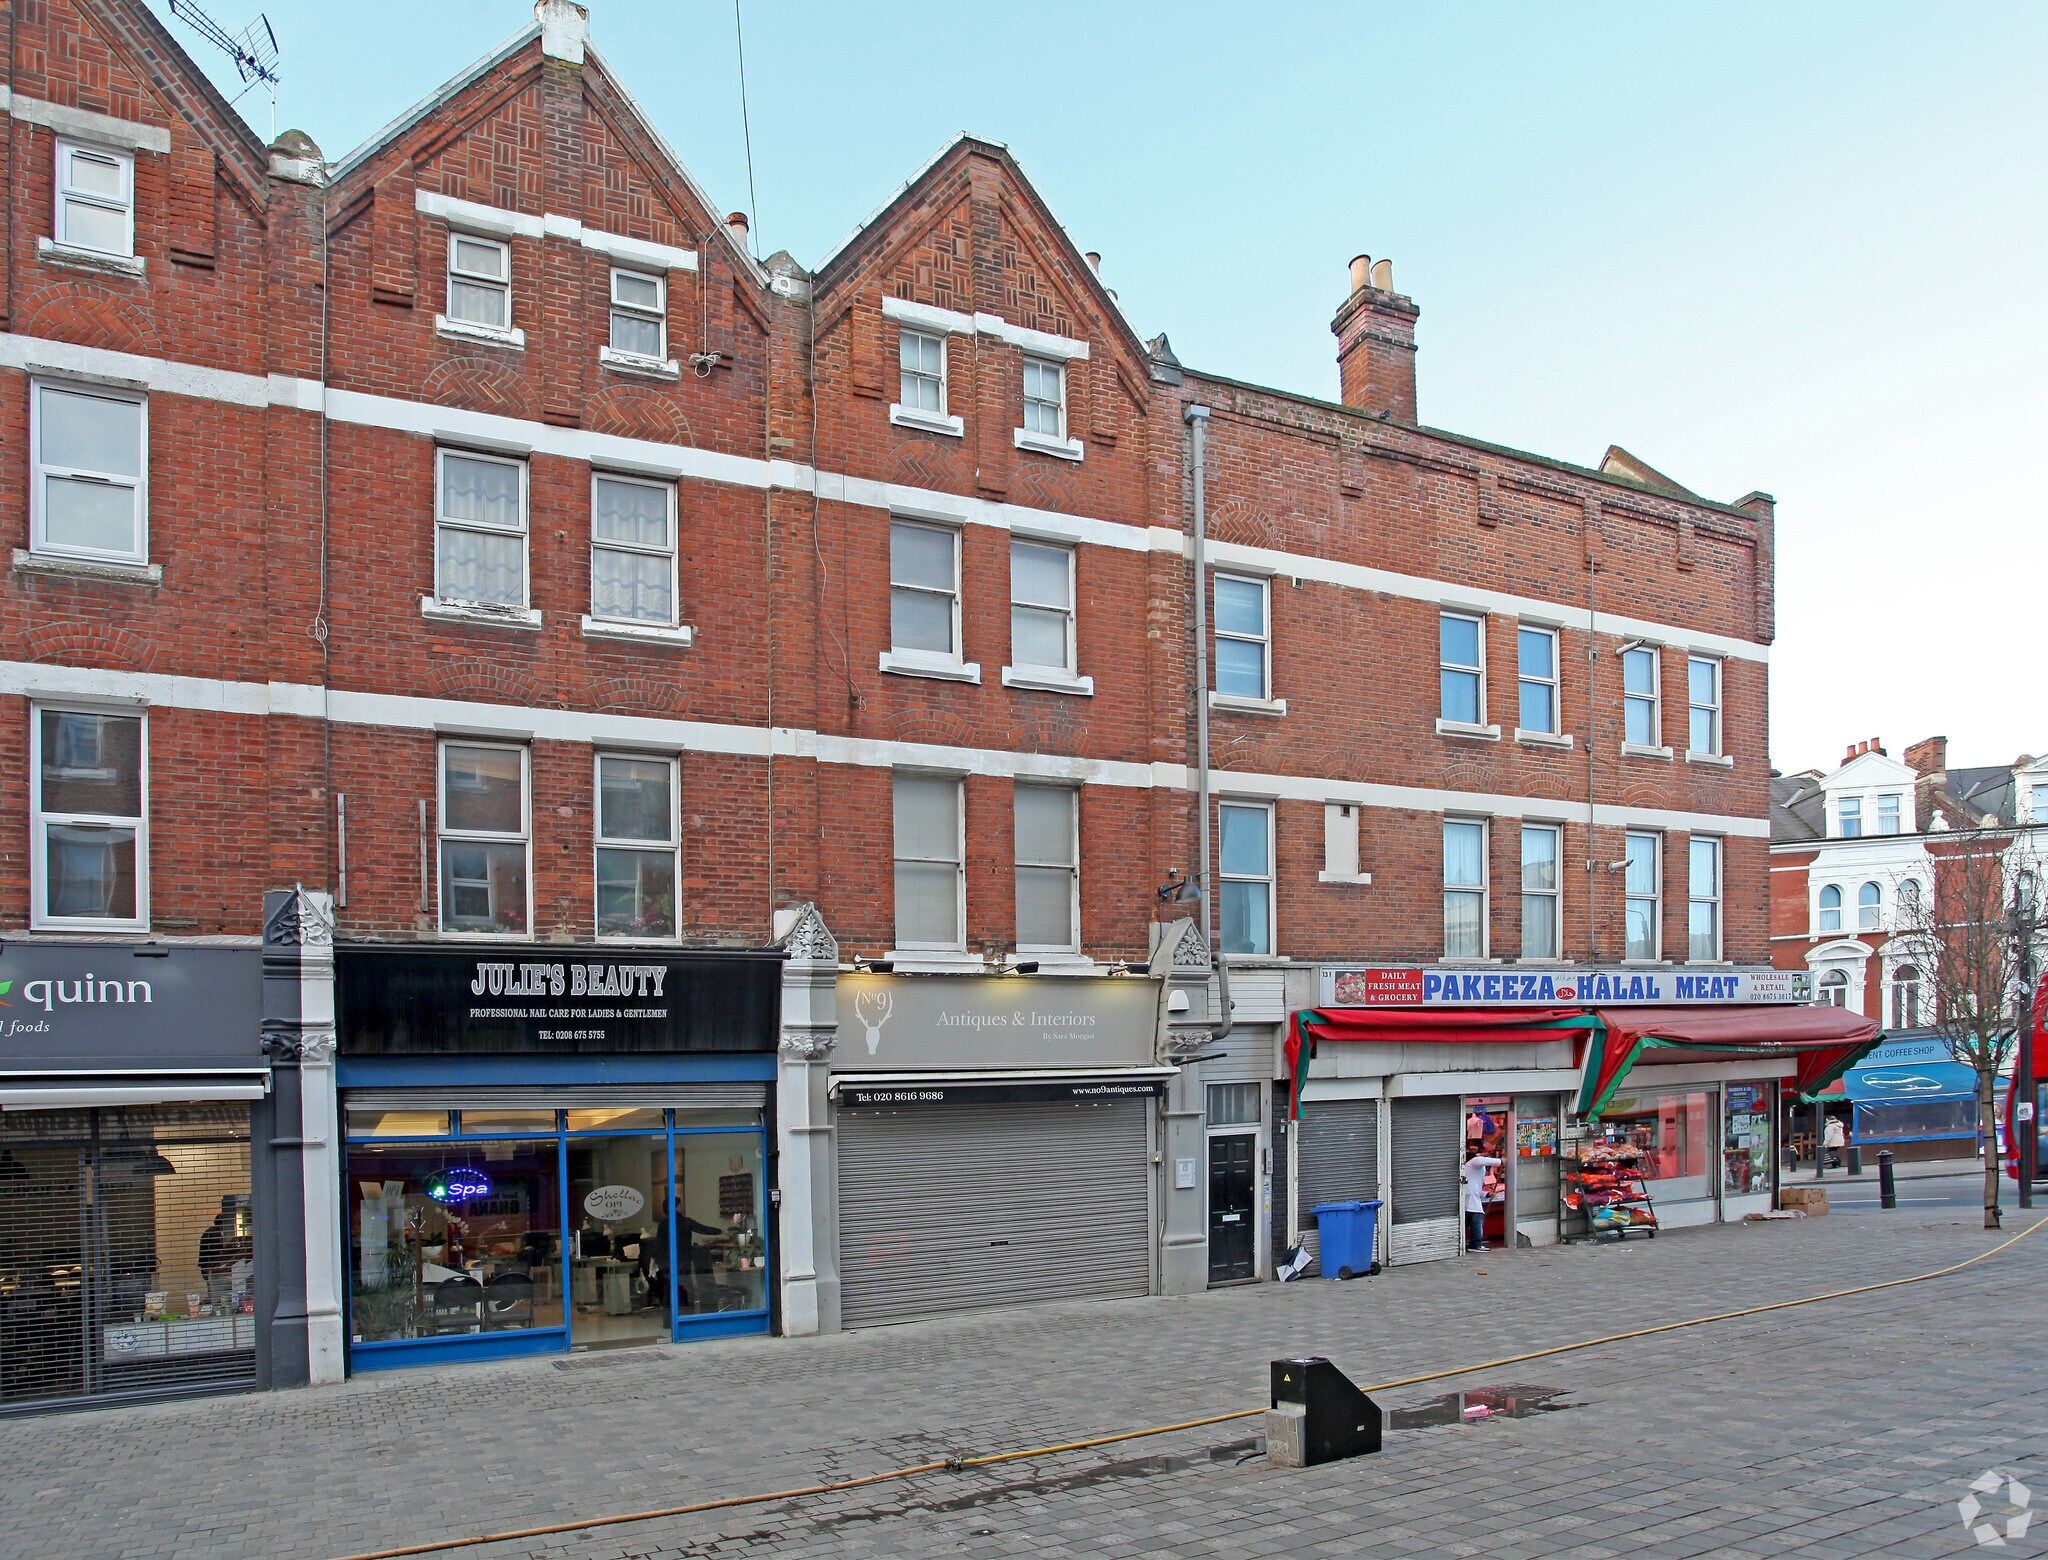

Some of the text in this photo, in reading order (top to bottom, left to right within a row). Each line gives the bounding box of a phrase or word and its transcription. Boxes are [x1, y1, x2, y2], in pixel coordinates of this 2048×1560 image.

[471, 963, 667, 997] JULIE'S BEAUTY
[1381, 972, 1407, 980] DAILY
[23, 972, 153, 1011] quinn
[1423, 975, 1739, 1000] PAKEEZA HALAL MEAT
[470, 1008, 667, 1018] PROFESSIONAL NAIL CARE FOR LADIES & GENTLEMEN
[936, 1011, 1096, 1031] Antiques & Interiors
[5, 1020, 50, 1037] foods
[538, 1030, 605, 1040] TEL: 0208 675 5755
[1043, 1032, 1052, 1040] By
[1069, 1033, 1095, 1041] Morgan
[1864, 1046, 1935, 1060] ENT COFFEE SHOP
[856, 1090, 944, 1102] Tel: 020 8616 9686
[1072, 1085, 1154, 1095] www.no9antiques.com
[429, 1174, 477, 1185] Nails
[433, 1185, 446, 1197] &
[447, 1183, 488, 1197] Spa
[605, 1200, 623, 1208] OPI
